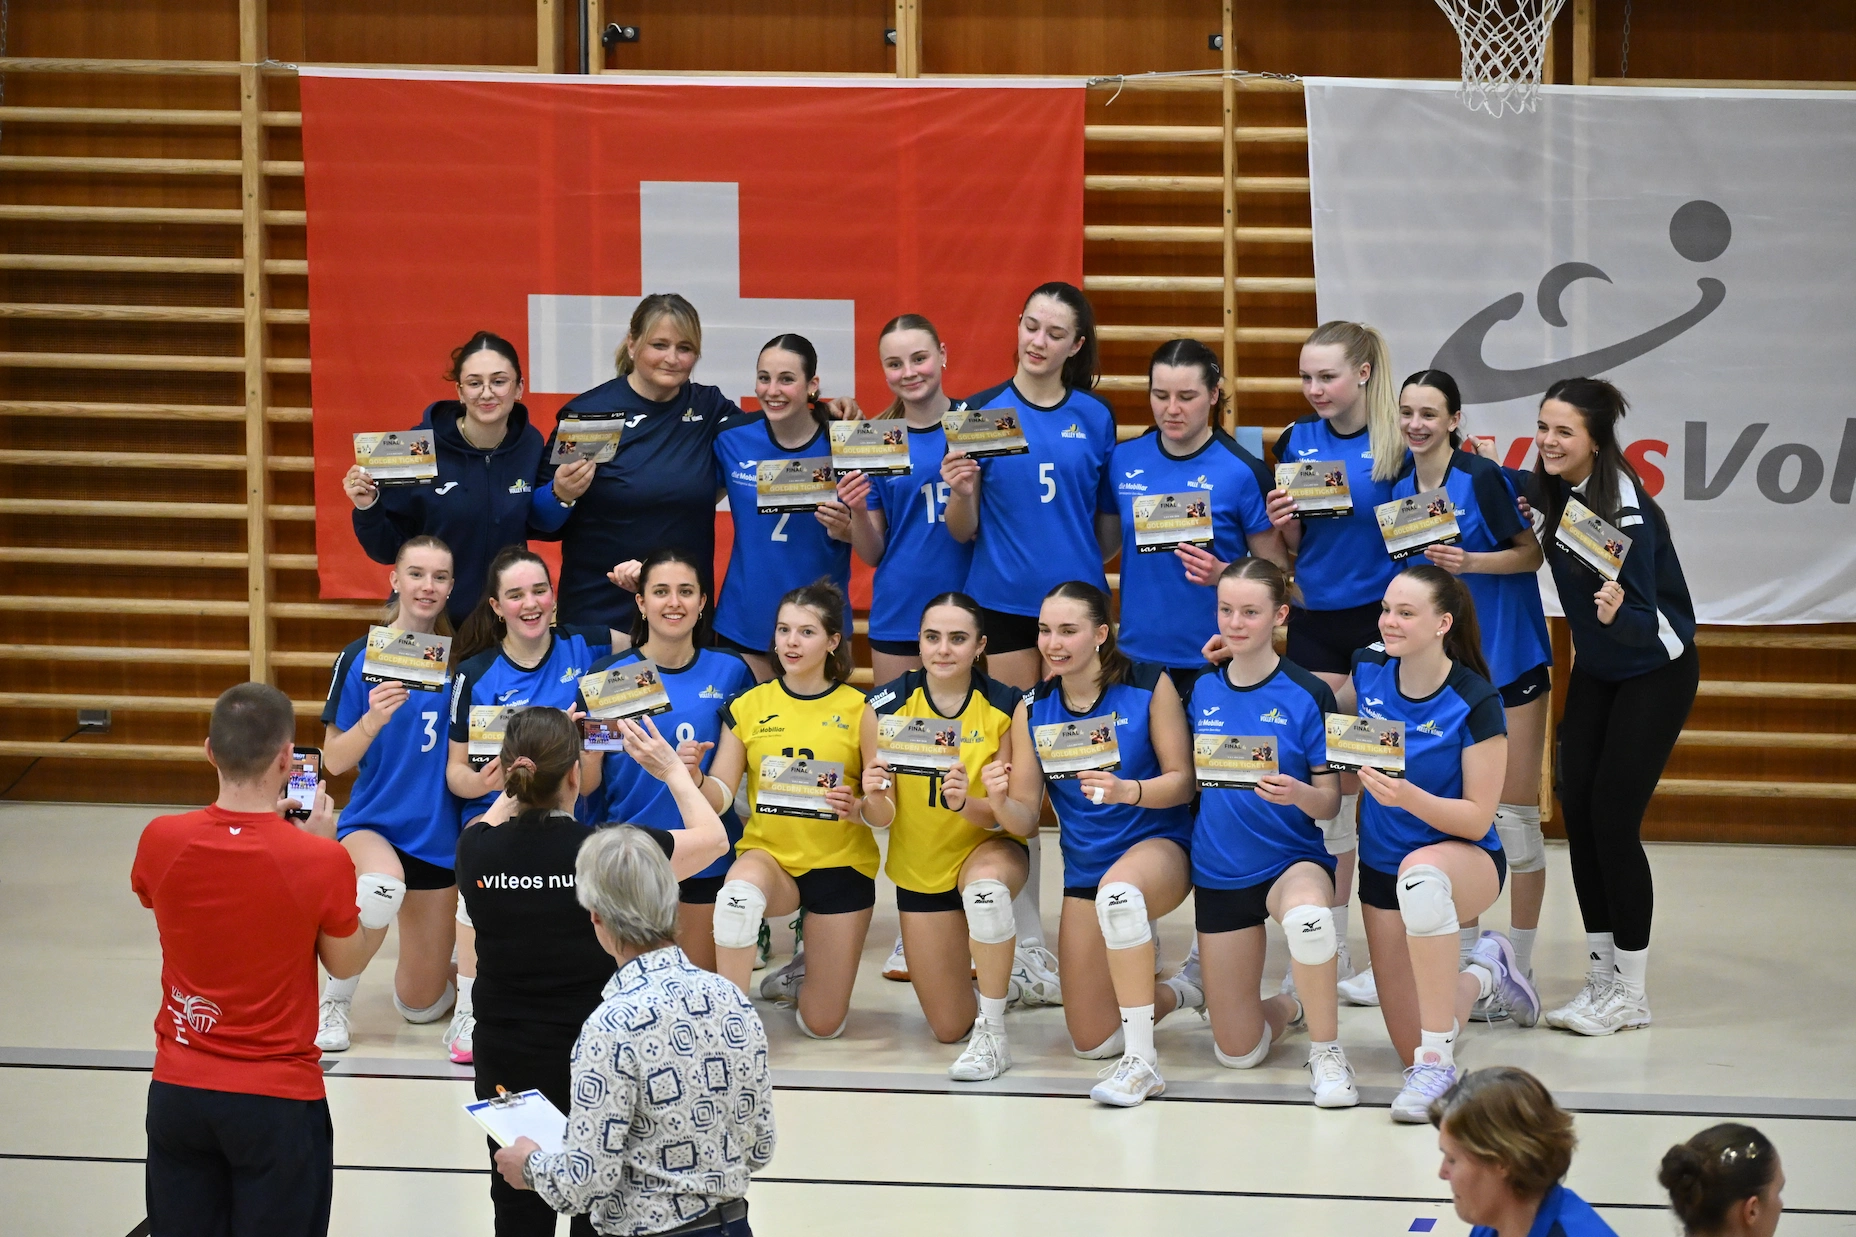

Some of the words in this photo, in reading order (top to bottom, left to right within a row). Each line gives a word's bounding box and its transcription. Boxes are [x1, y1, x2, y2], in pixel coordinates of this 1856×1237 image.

[843, 446, 871, 454] GOLDEN
[1039, 463, 1056, 503] 5
[921, 482, 951, 523] 15
[1146, 521, 1175, 529] GOLDEN
[1393, 526, 1419, 536] GOLDEN
[1420, 518, 1442, 529] TICKET
[1569, 527, 1592, 547] GOLDEN
[1592, 543, 1612, 560] TICKET
[378, 654, 409, 666] GOLDEN
[410, 660, 435, 668] TICKET
[598, 694, 627, 706] GOLDEN
[628, 687, 652, 698] TICKET
[421, 711, 438, 752] 3
[890, 742, 920, 751] GOLDEN
[921, 745, 947, 753] TICKET
[1051, 749, 1078, 758] GOLDEN
[1080, 745, 1105, 753] TICKET
[1338, 741, 1365, 751] GOLDEN
[1366, 745, 1392, 754] TICKET
[771, 784, 802, 793] GOLDEN
[803, 787, 828, 795] TICKET
[483, 872, 543, 889] viteos
[548, 874, 576, 889] nu
